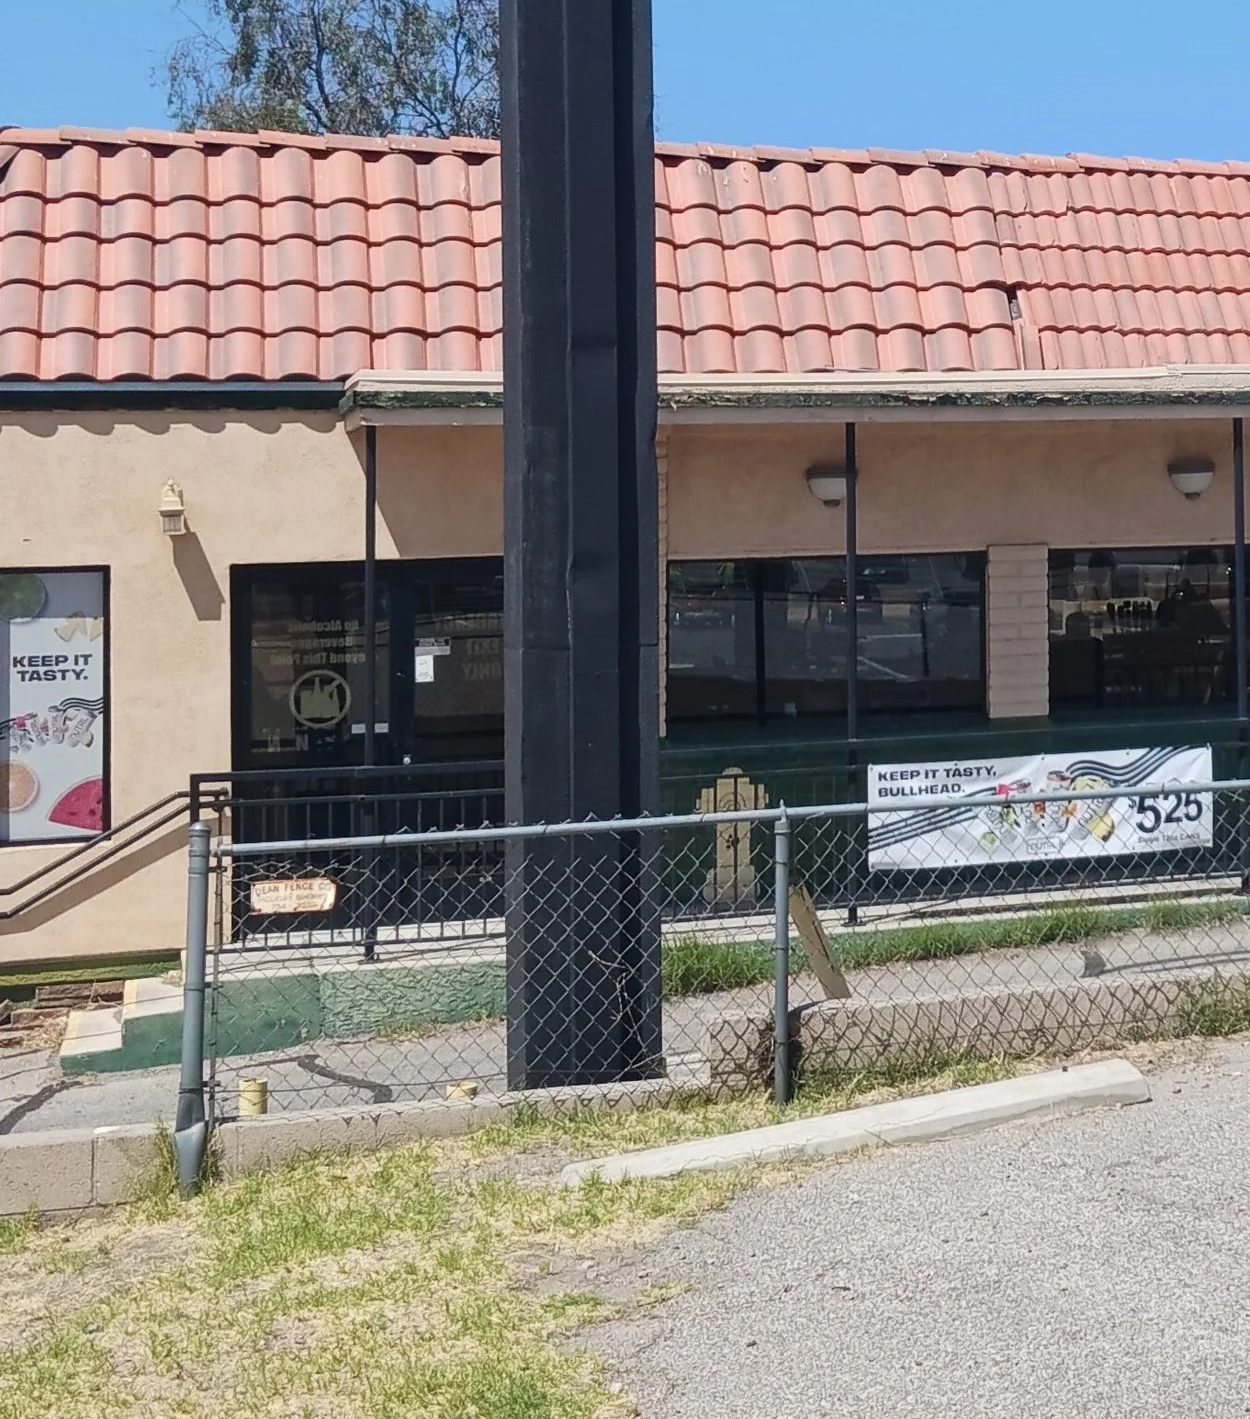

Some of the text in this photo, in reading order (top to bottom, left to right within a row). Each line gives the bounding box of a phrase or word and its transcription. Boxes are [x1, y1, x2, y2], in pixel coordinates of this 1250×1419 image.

[13, 654, 93, 668] KEEP IT
[17, 668, 88, 682] TASTY.
[878, 770, 920, 782] KEEP
[925, 768, 940, 780] IT
[878, 783, 965, 798] BULLHEAD.
[284, 882, 314, 892] FENCE
